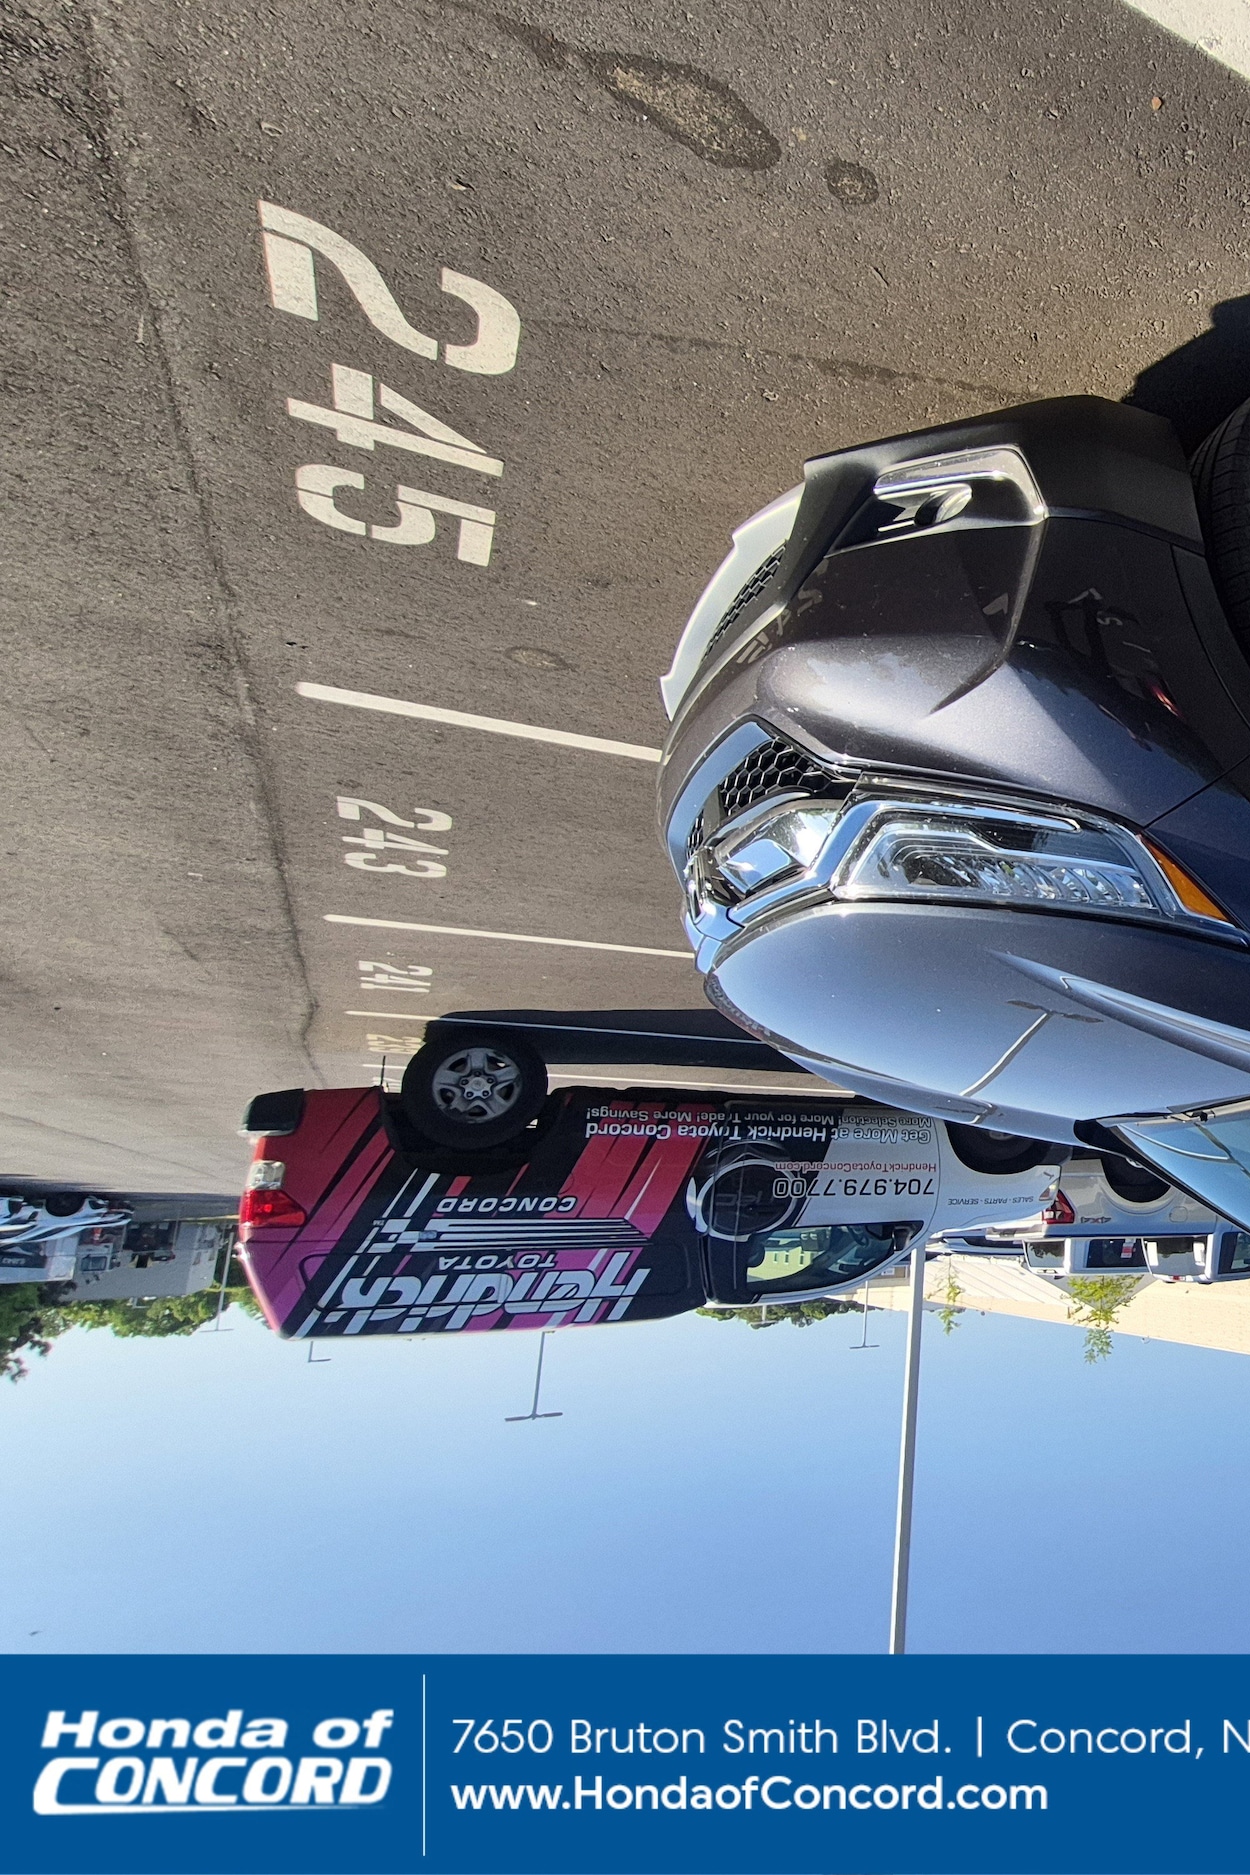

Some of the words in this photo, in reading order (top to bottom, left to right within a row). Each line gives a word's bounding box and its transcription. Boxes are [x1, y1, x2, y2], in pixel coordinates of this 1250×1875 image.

[259, 199, 521, 567] 245
[337, 796, 452, 878] 243
[359, 961, 433, 993] 241
[586, 1106, 649, 1122] Savings!
[653, 1110, 692, 1122] More
[696, 1111, 741, 1123] Trade!
[744, 1111, 774, 1123] your
[777, 1113, 797, 1125] for
[800, 1114, 834, 1126] More
[838, 1115, 898, 1127] Selection!
[900, 1117, 931, 1128] More
[586, 1122, 672, 1140] Concord
[679, 1121, 739, 1141] Toyota
[748, 1125, 826, 1142] Hendrick
[830, 1127, 850, 1140] at
[853, 1128, 898, 1143] More
[902, 1129, 931, 1143] Get
[775, 1160, 936, 1174] HendrickToyotaConcord.com
[773, 1178, 936, 1198] 704.979.7700
[436, 1196, 578, 1213] CONCORD
[947, 1198, 979, 1206] SERVICE
[1012, 1196, 1034, 1204] SALES
[438, 1254, 556, 1271] TOYOTA
[324, 1252, 651, 1334] Hendrick
